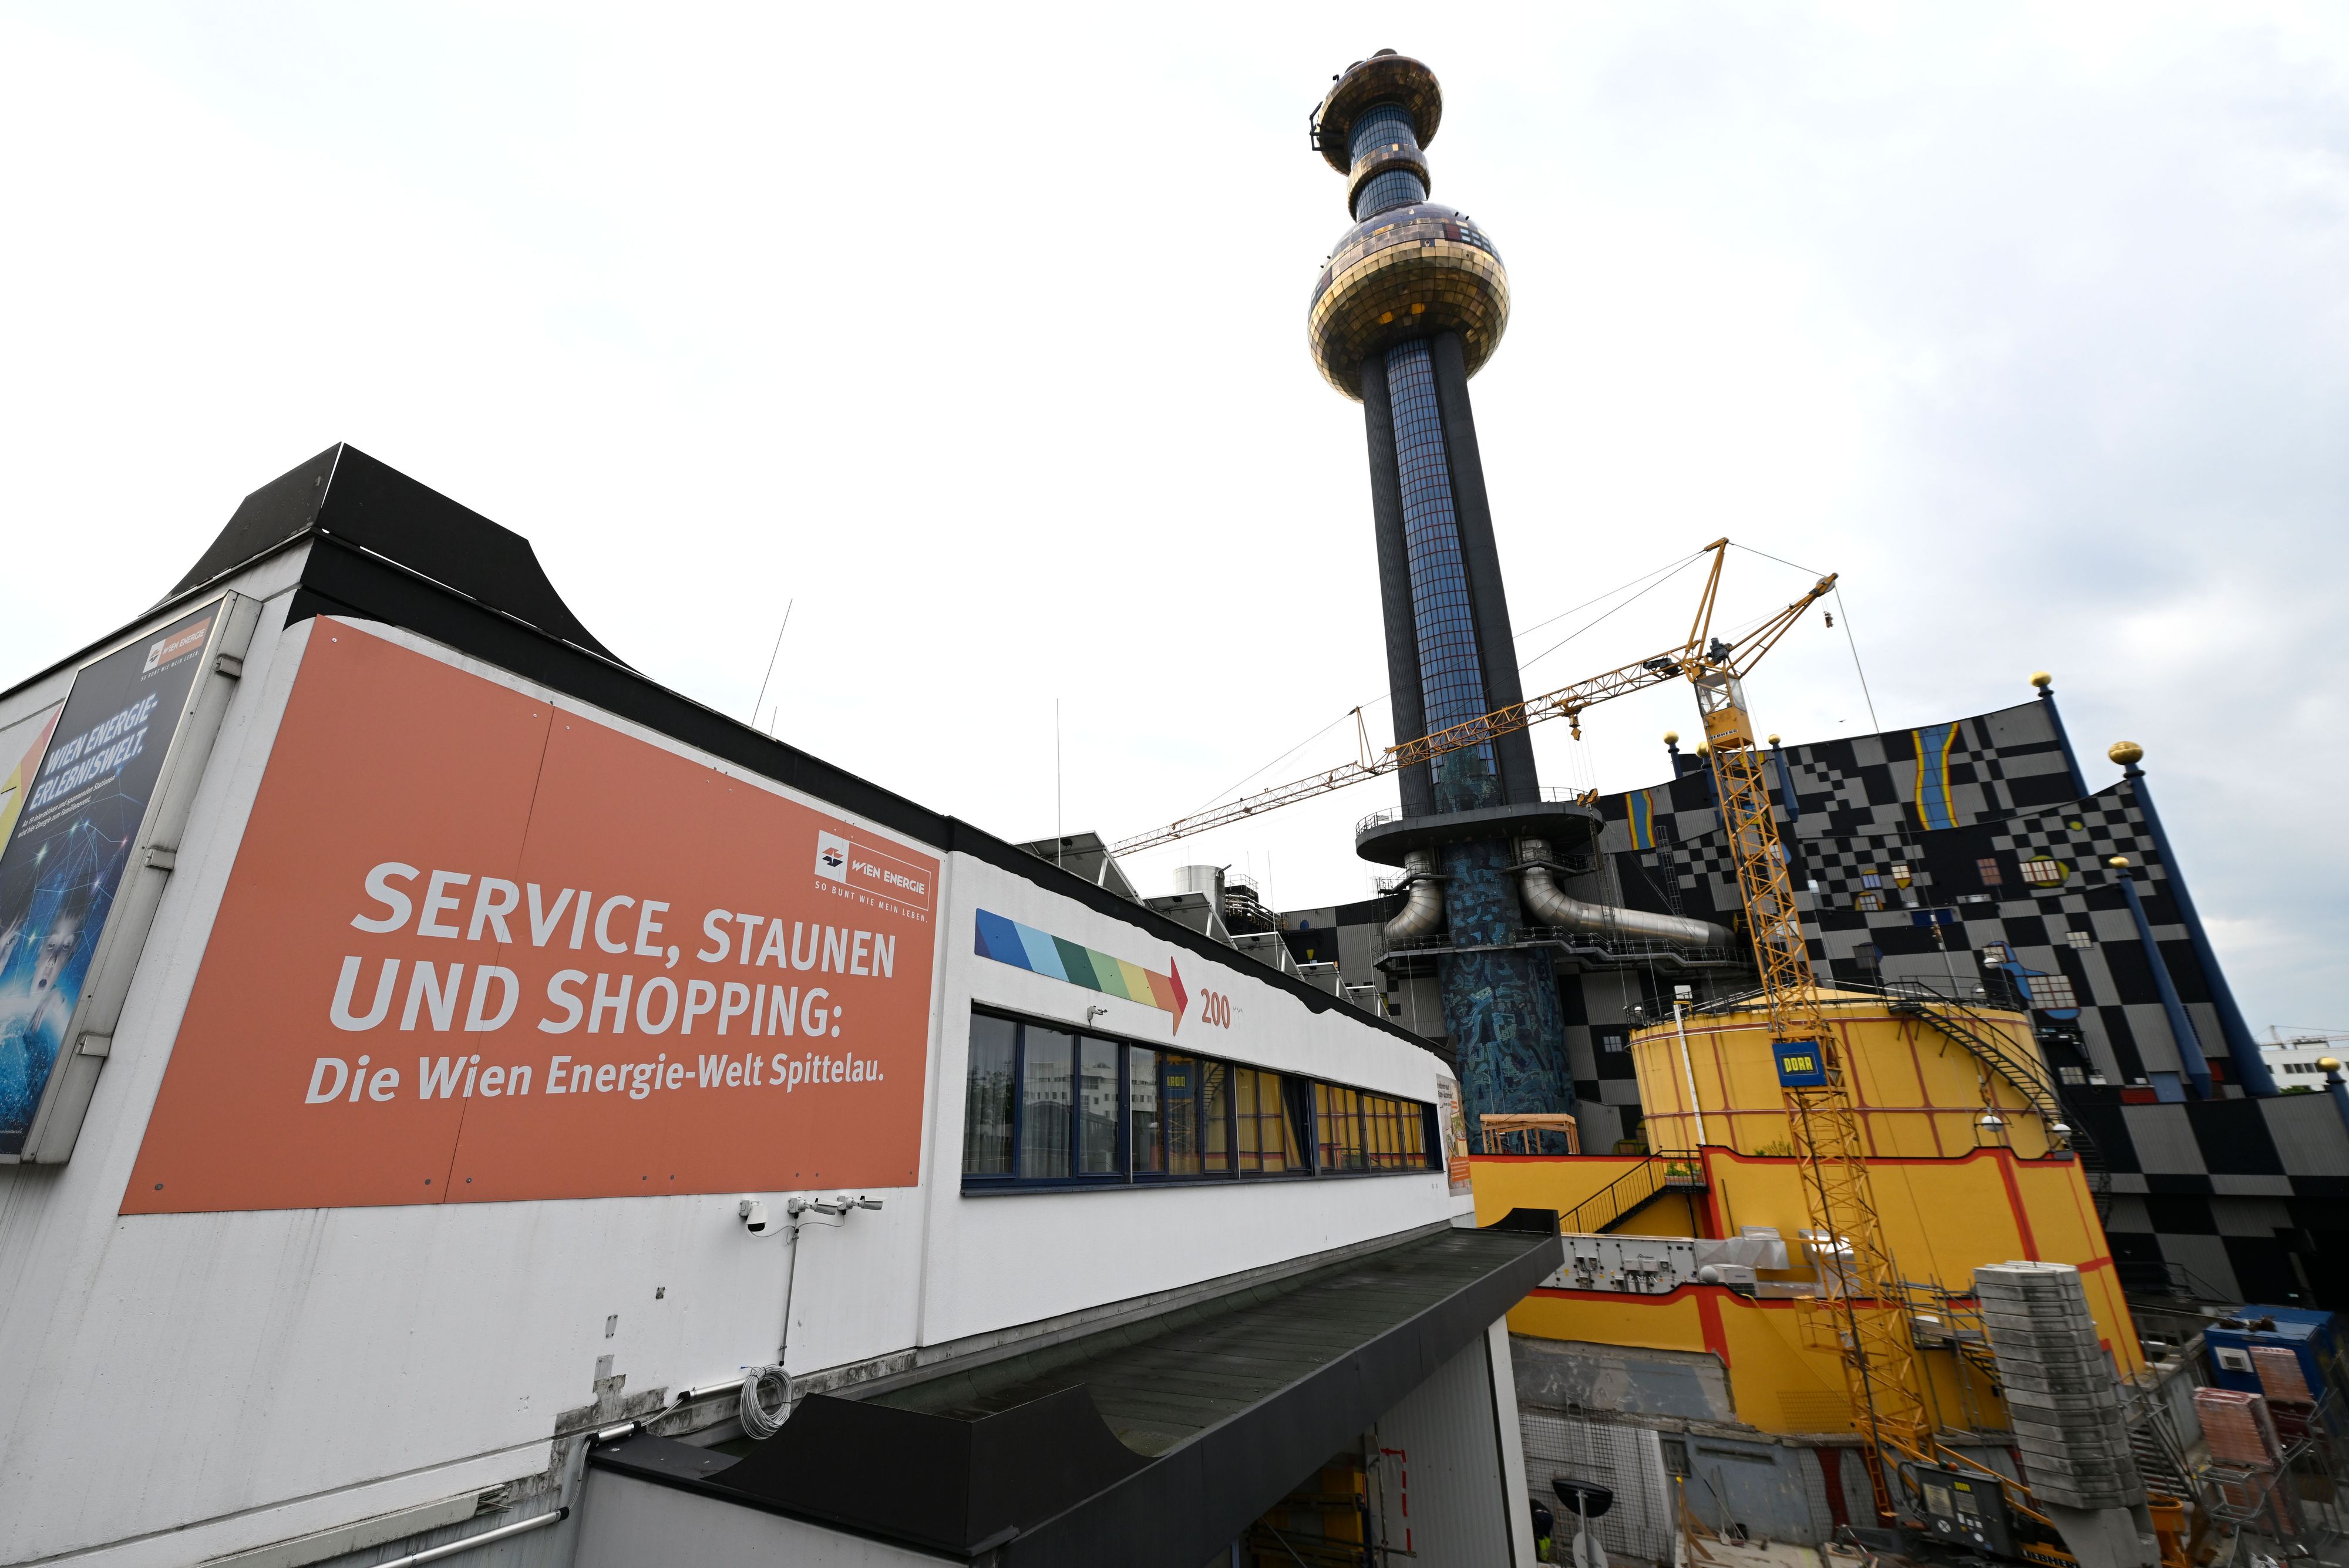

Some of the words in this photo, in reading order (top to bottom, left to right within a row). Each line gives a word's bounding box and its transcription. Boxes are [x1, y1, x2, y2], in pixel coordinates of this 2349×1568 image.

[163, 641, 180, 655] WIEN
[179, 628, 206, 647] ENERGIE
[161, 664, 170, 672] WIE
[45, 733, 88, 776] WIEN
[84, 693, 158, 755] ENERGIE-
[29, 726, 148, 811] ERLEBNISWELT.
[852, 860, 881, 879] WIEN
[883, 870, 925, 895] ENERGIE
[350, 862, 680, 969] SERVICE,
[696, 909, 896, 978] STAUNEN
[815, 881, 827, 891] SO
[832, 887, 855, 900] BUNT
[859, 894, 874, 906] WIE
[878, 901, 898, 914] MEIN
[901, 908, 928, 923] LEBEN.
[329, 955, 520, 1032] UND
[537, 969, 842, 1038] SHOPPING:
[1200, 988, 1230, 1029] 200
[305, 1055, 400, 1104] Die
[419, 1054, 533, 1100] Wien
[546, 1052, 764, 1101] Energie-Welt
[769, 1052, 884, 1093] Spittelau.
[1783, 1056, 1813, 1073] PORR
